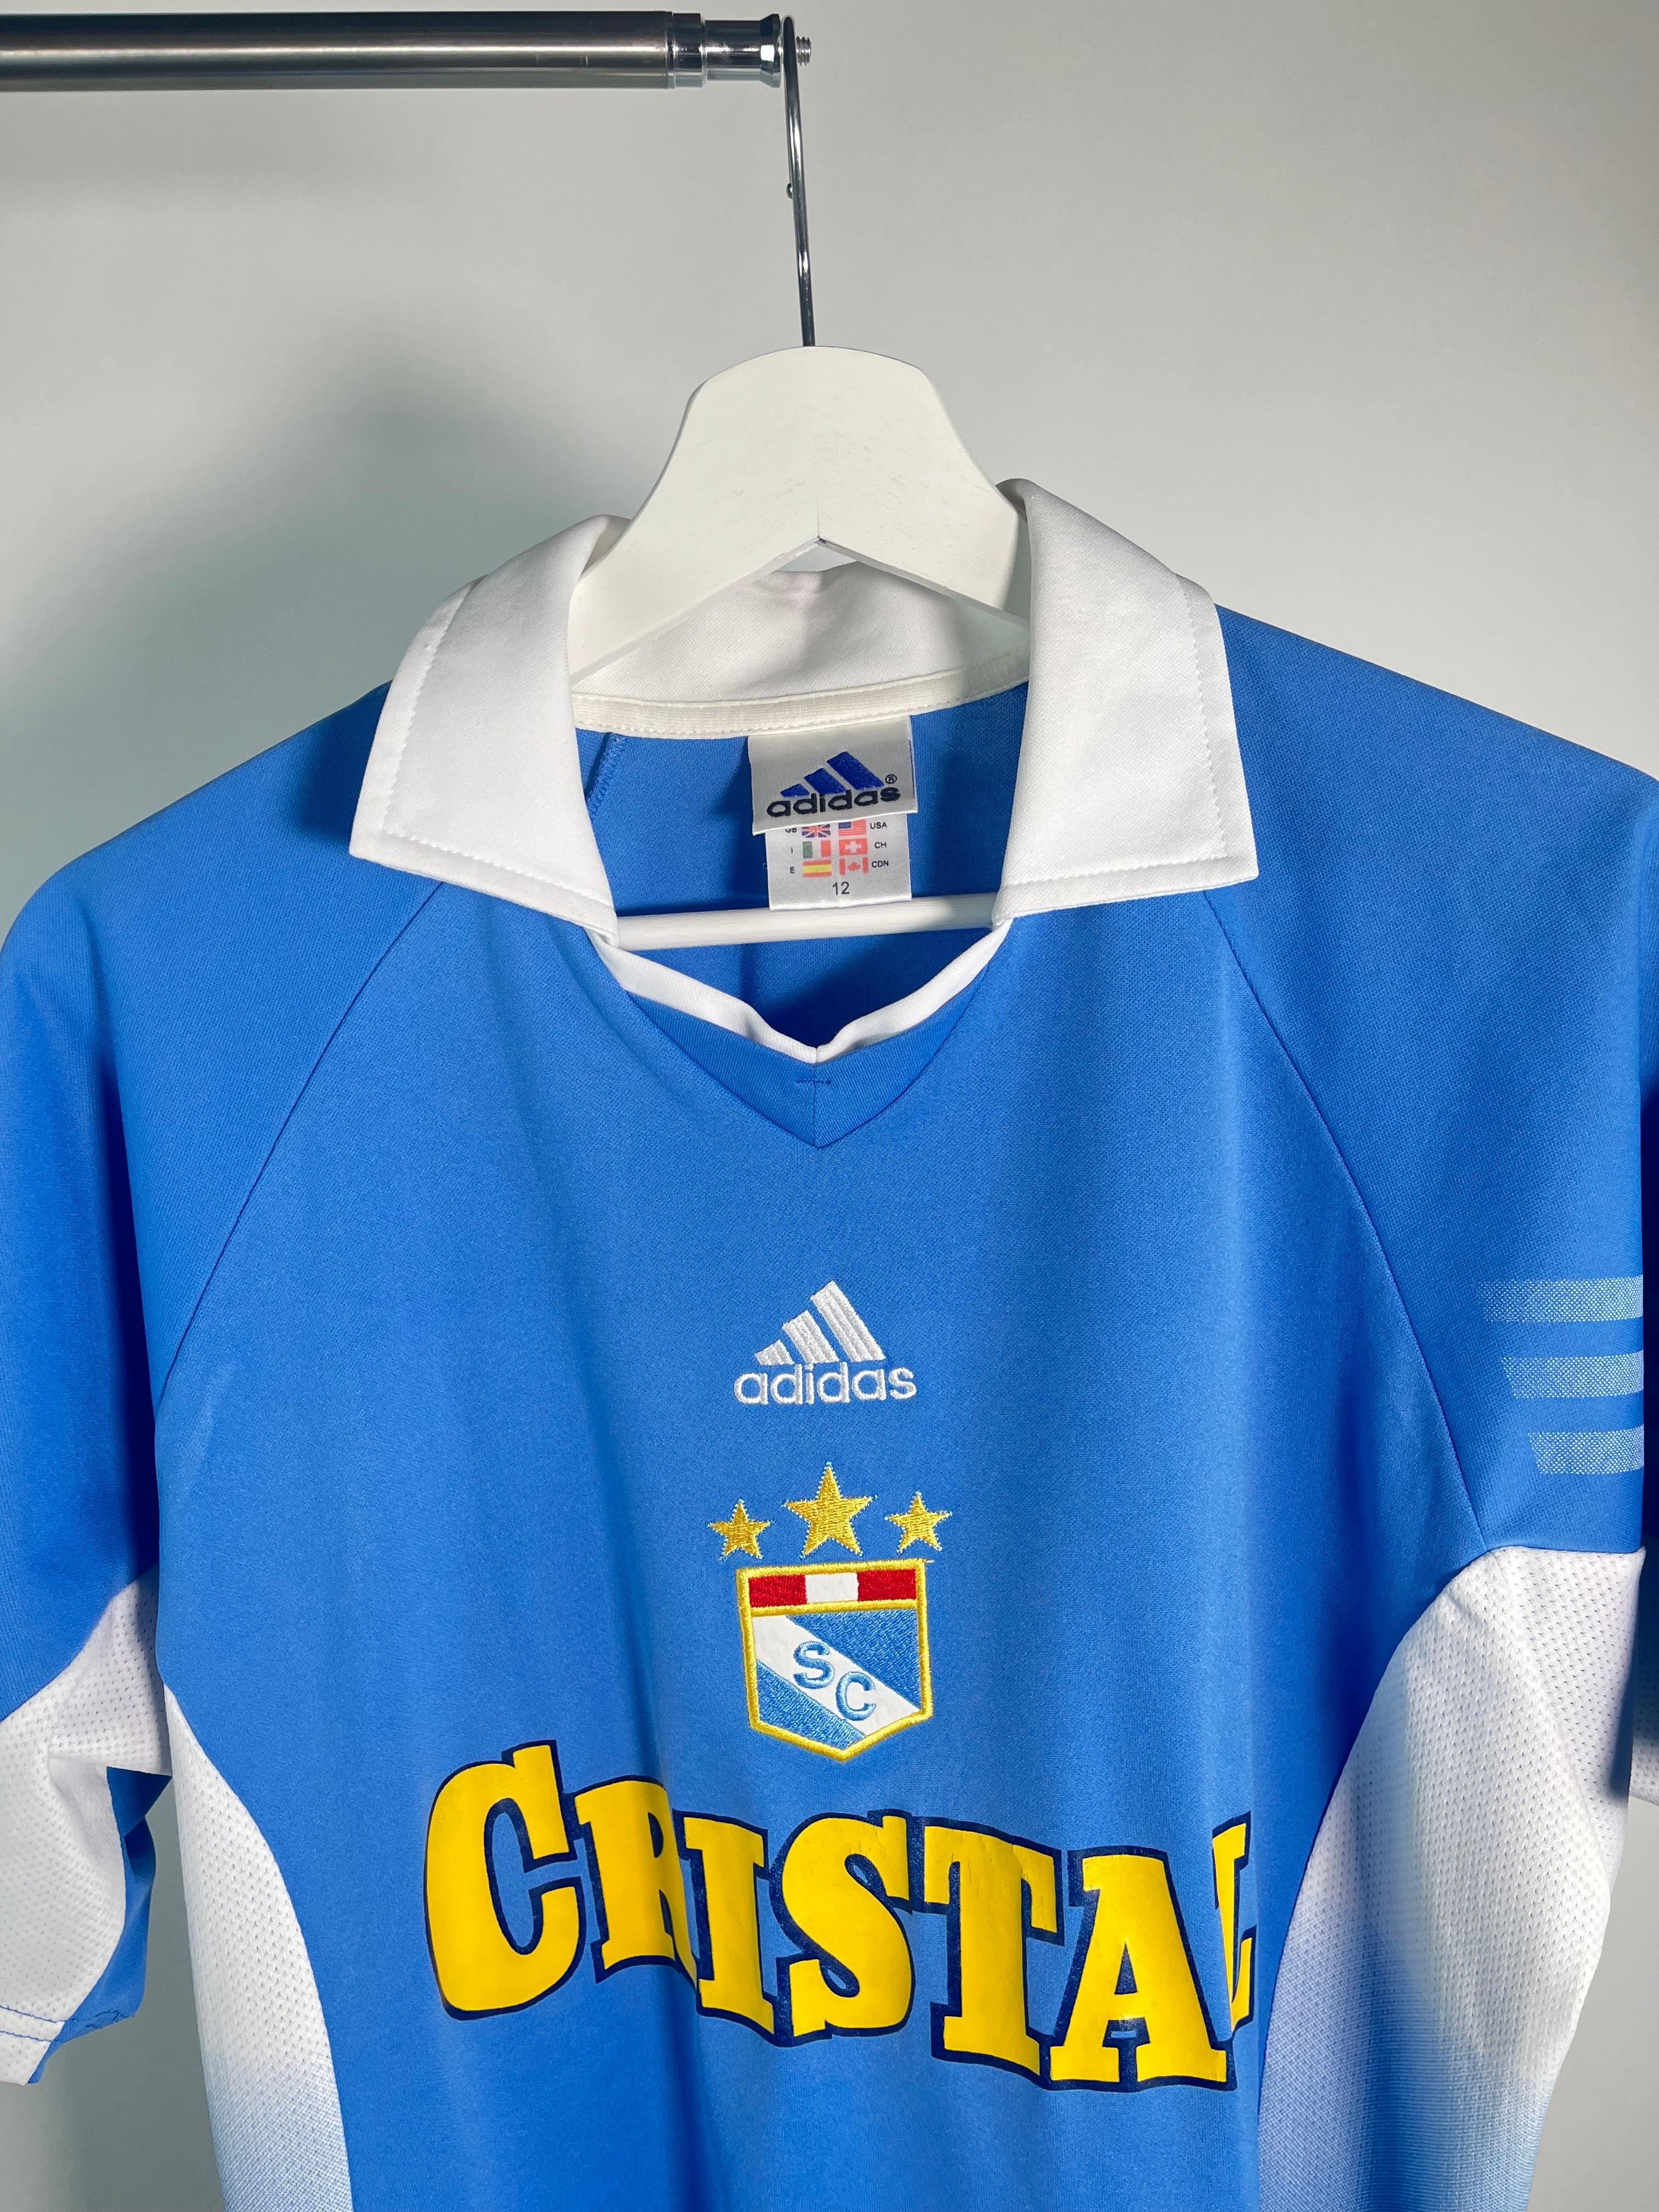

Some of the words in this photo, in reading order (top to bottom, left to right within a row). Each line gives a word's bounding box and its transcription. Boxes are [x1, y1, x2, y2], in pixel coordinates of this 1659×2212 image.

[766, 787, 901, 817] adidas
[832, 881, 850, 895] 12
[733, 1361, 917, 1405] adidas
[793, 1640, 877, 1721] SC
